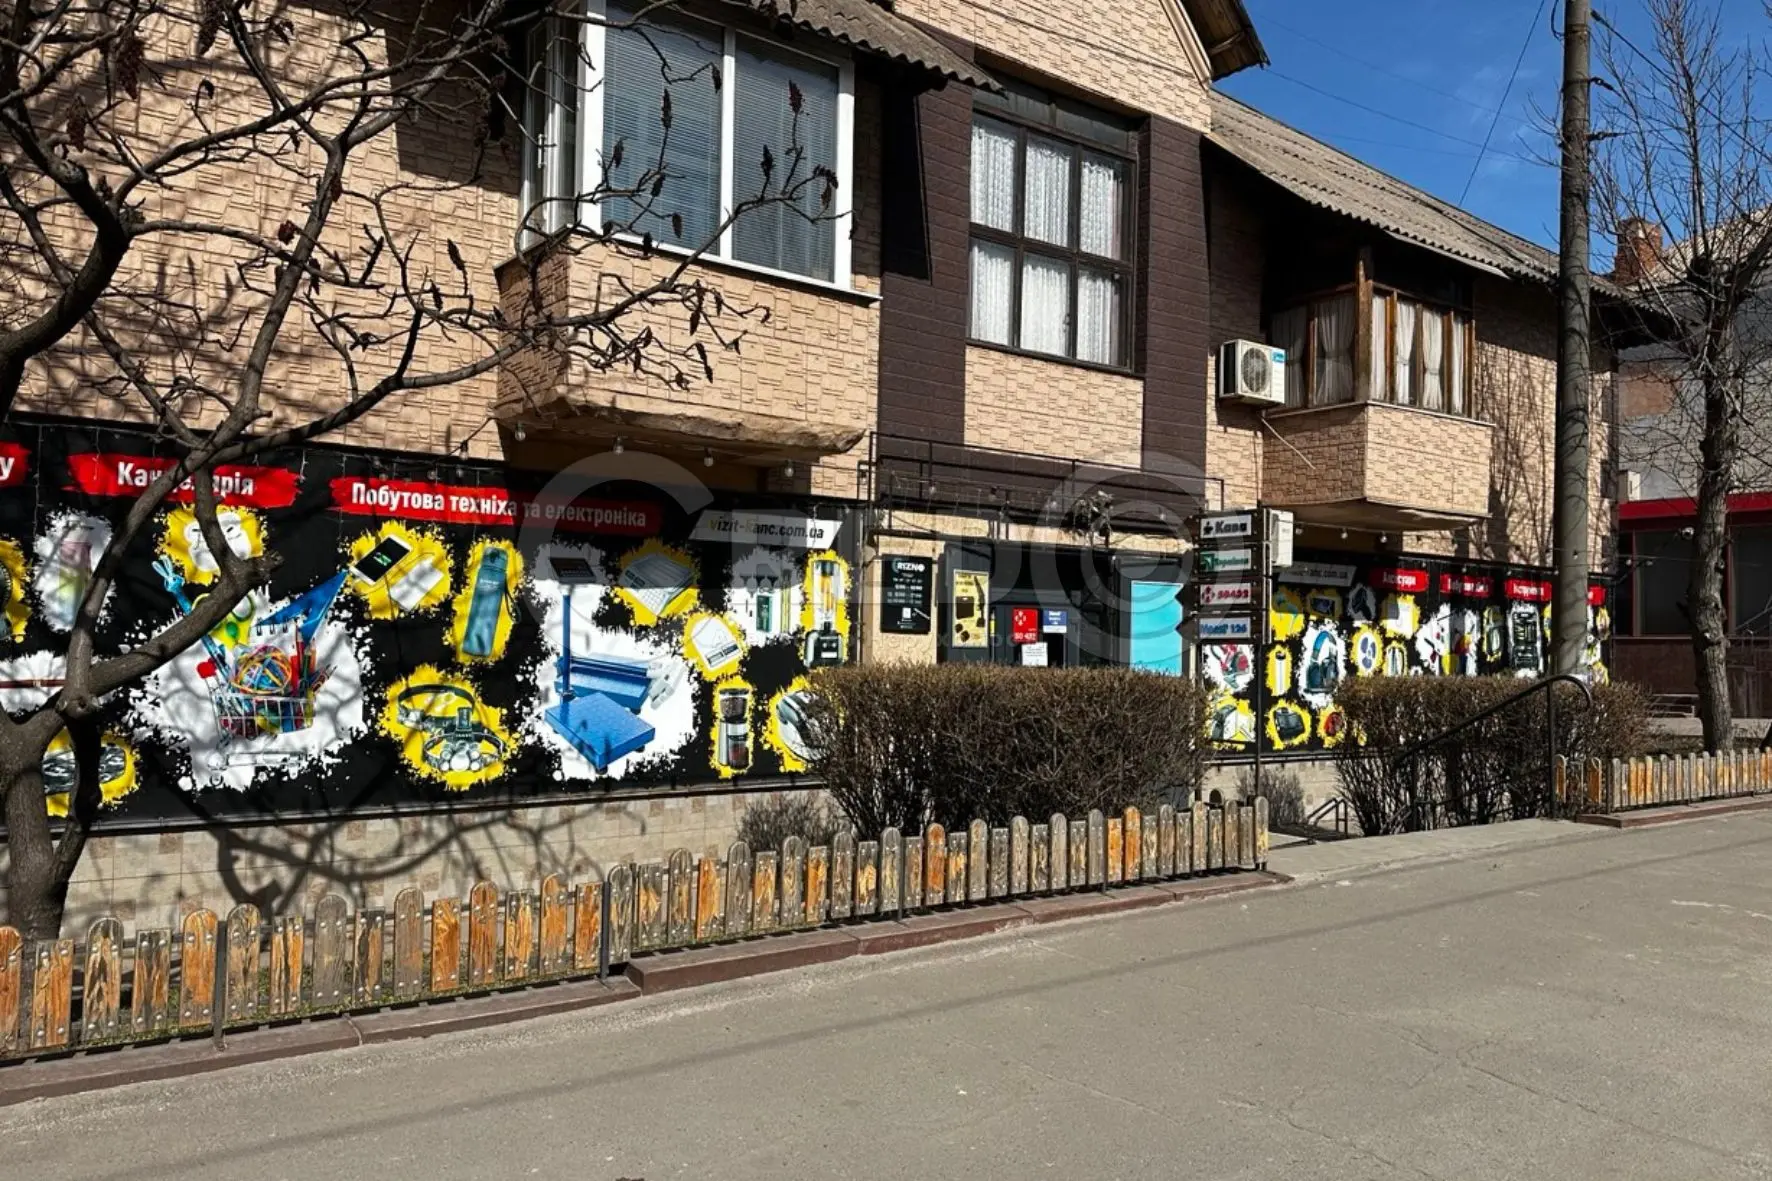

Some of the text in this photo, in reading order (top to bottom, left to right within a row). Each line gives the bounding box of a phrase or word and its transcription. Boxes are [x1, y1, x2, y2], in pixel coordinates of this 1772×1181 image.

[352, 482, 445, 512] Побутова
[523, 502, 541, 519] та
[545, 503, 646, 528] електроніка
